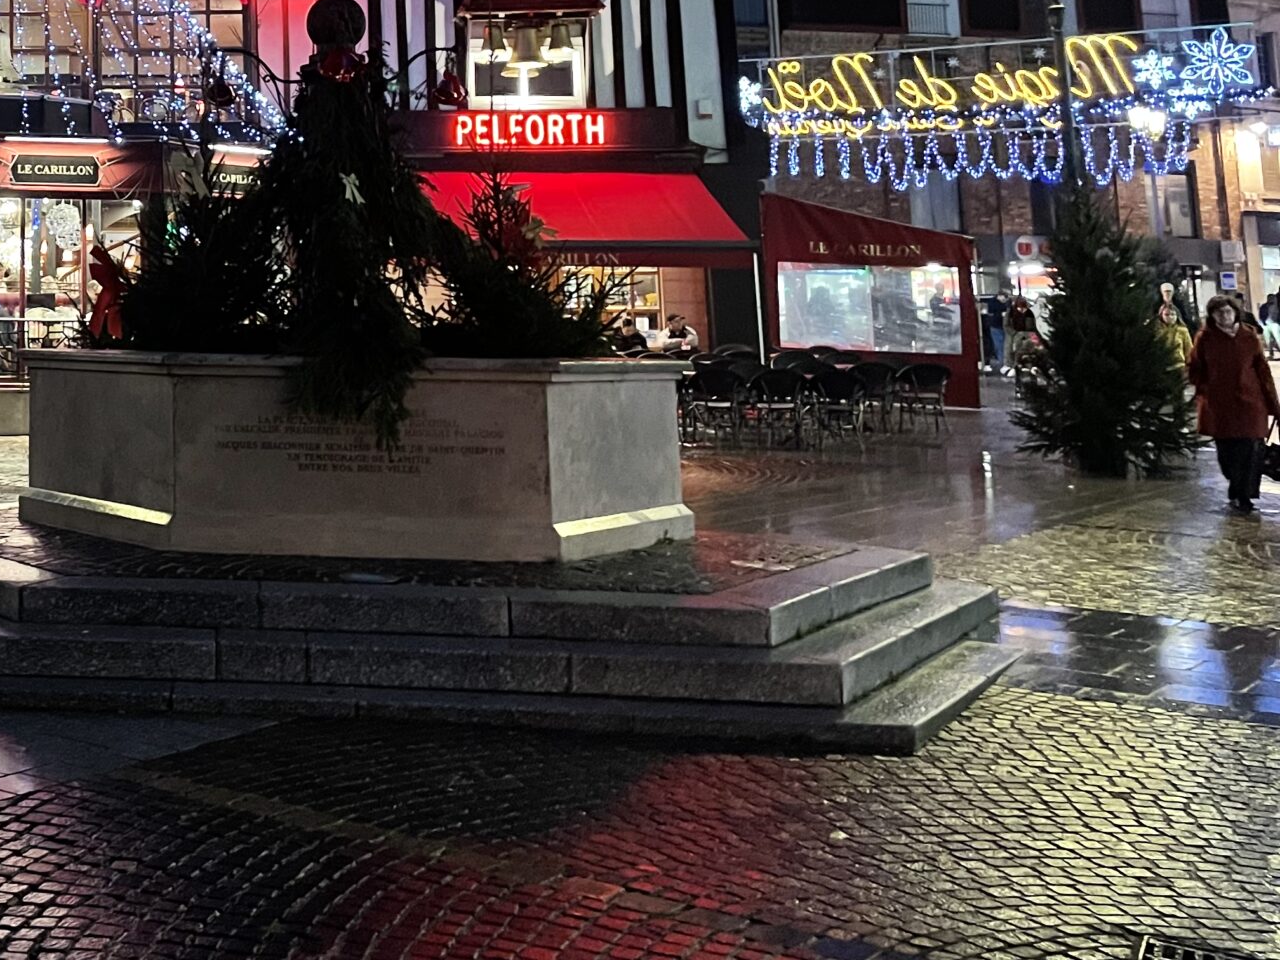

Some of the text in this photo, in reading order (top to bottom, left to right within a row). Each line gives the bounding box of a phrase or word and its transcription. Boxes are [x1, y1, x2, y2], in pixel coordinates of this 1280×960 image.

[456, 113, 605, 145] PELFORTH
[17, 164, 94, 176] LE CARILLON
[809, 240, 829, 254] LE
[298, 462, 328, 472] ENTRE
